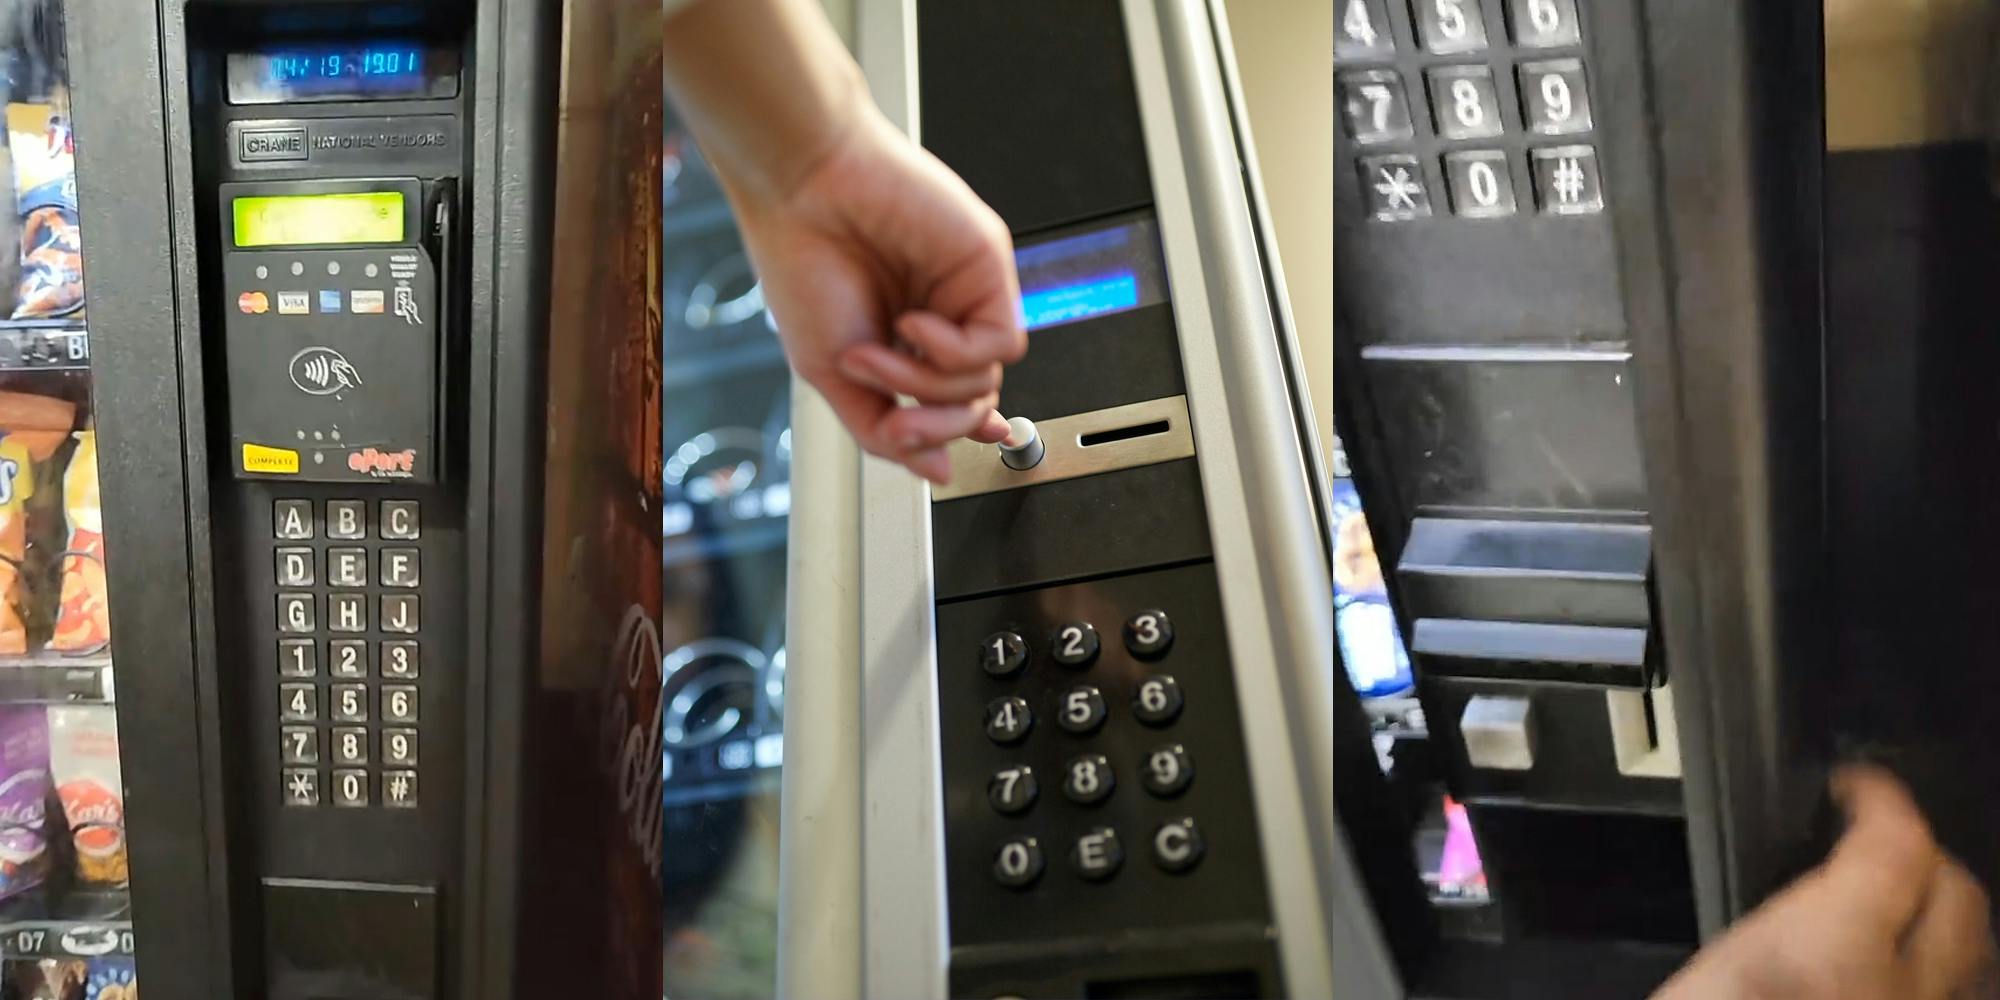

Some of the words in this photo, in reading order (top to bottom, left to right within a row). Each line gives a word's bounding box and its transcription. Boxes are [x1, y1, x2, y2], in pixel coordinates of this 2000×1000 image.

[1343, 0, 1378, 47] 4
[1435, 0, 1466, 40] 5
[1528, 0, 1559, 34] 6
[1359, 84, 1392, 130] 7
[1451, 79, 1483, 127] 8
[1541, 73, 1571, 122] 9
[248, 136, 301, 153] CRANE
[312, 133, 376, 149] NATIONAL
[380, 132, 447, 147] VENDORS
[1469, 161, 1498, 207] 0
[248, 455, 294, 466] COMPLETE
[284, 506, 303, 534] A
[338, 507, 357, 535] B
[391, 508, 409, 535] C
[286, 554, 305, 582] D
[340, 554, 356, 582] E
[392, 555, 408, 582] F
[288, 599, 306, 628] G
[340, 600, 358, 628] H
[391, 601, 407, 628] J
[992, 637, 1005, 666] 1
[1061, 626, 1085, 657] 2
[1134, 615, 1161, 644] 3
[292, 645, 304, 672] 1
[340, 646, 358, 673] 2
[391, 646, 408, 673] 3
[290, 688, 307, 715] 4
[342, 689, 358, 716] 5
[391, 690, 408, 717] 6
[994, 702, 1018, 732] 4
[1067, 691, 1092, 723] 5
[1140, 680, 1168, 712] 6
[292, 732, 308, 758] 7
[342, 733, 358, 760] 8
[391, 734, 408, 760] 9
[342, 774, 359, 801] 0
[996, 769, 1020, 803] 7
[1072, 760, 1099, 793] 8
[1151, 750, 1179, 785] 9
[1000, 841, 1028, 876] 0
[1078, 833, 1107, 869] E
[1155, 823, 1191, 862] C
[18, 930, 45, 953] D7
